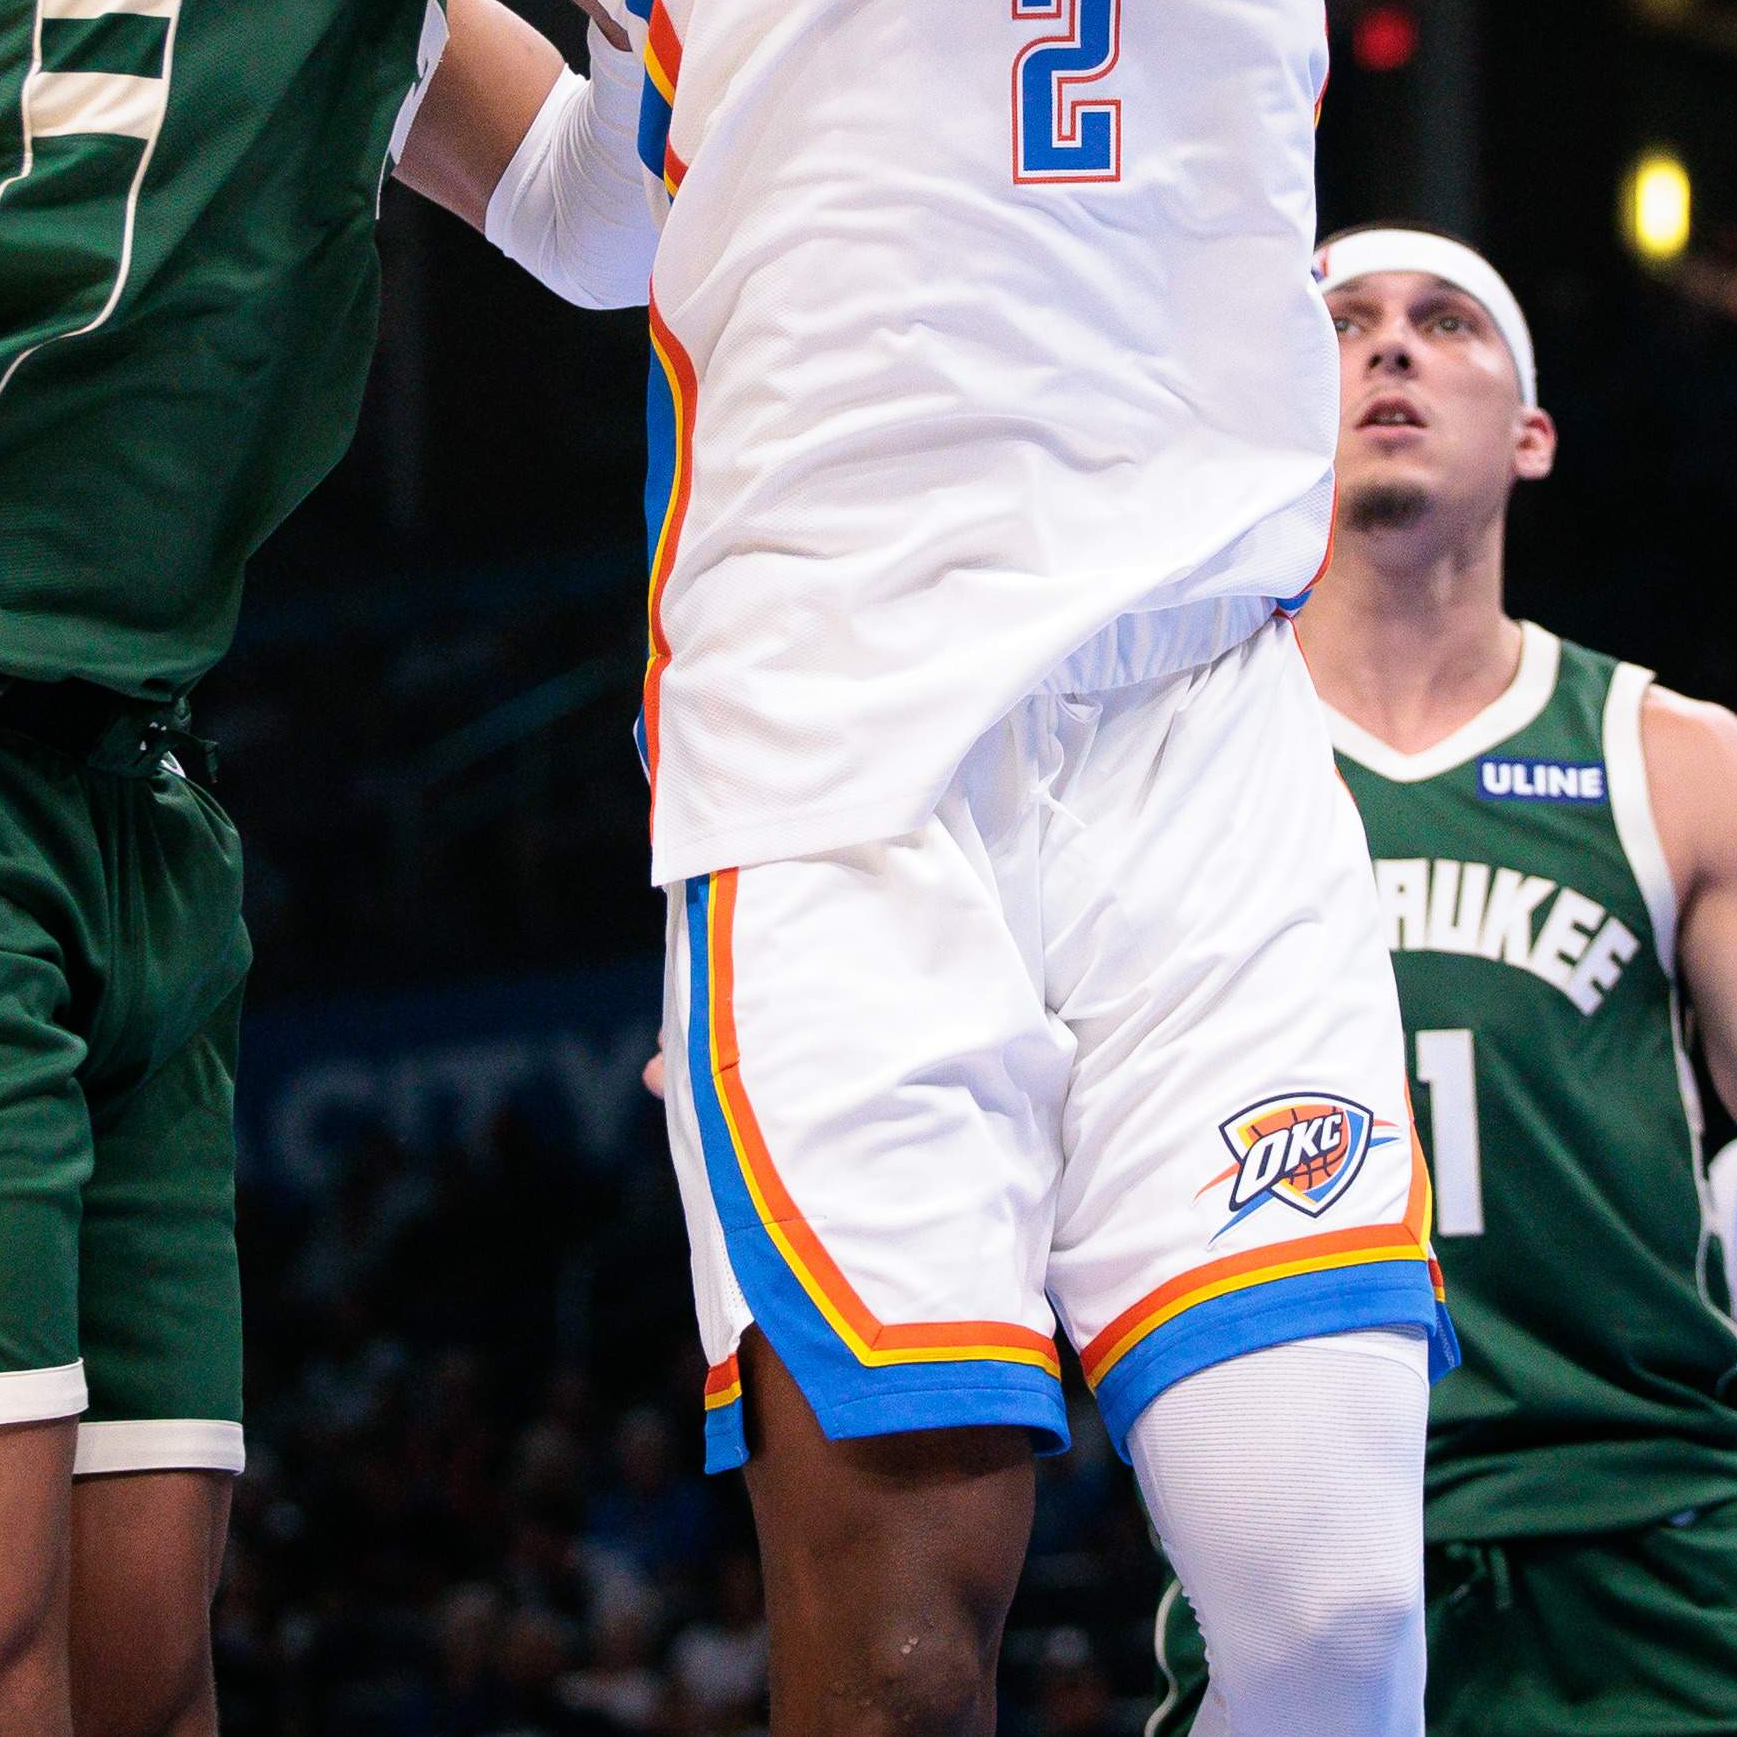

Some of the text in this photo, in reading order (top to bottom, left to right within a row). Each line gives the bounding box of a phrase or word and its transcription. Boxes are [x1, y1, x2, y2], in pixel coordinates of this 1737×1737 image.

[1481, 761, 1604, 799] ULINE
[1373, 856, 1642, 1016] AUKEE
[1229, 1112, 1344, 1210] OKC
